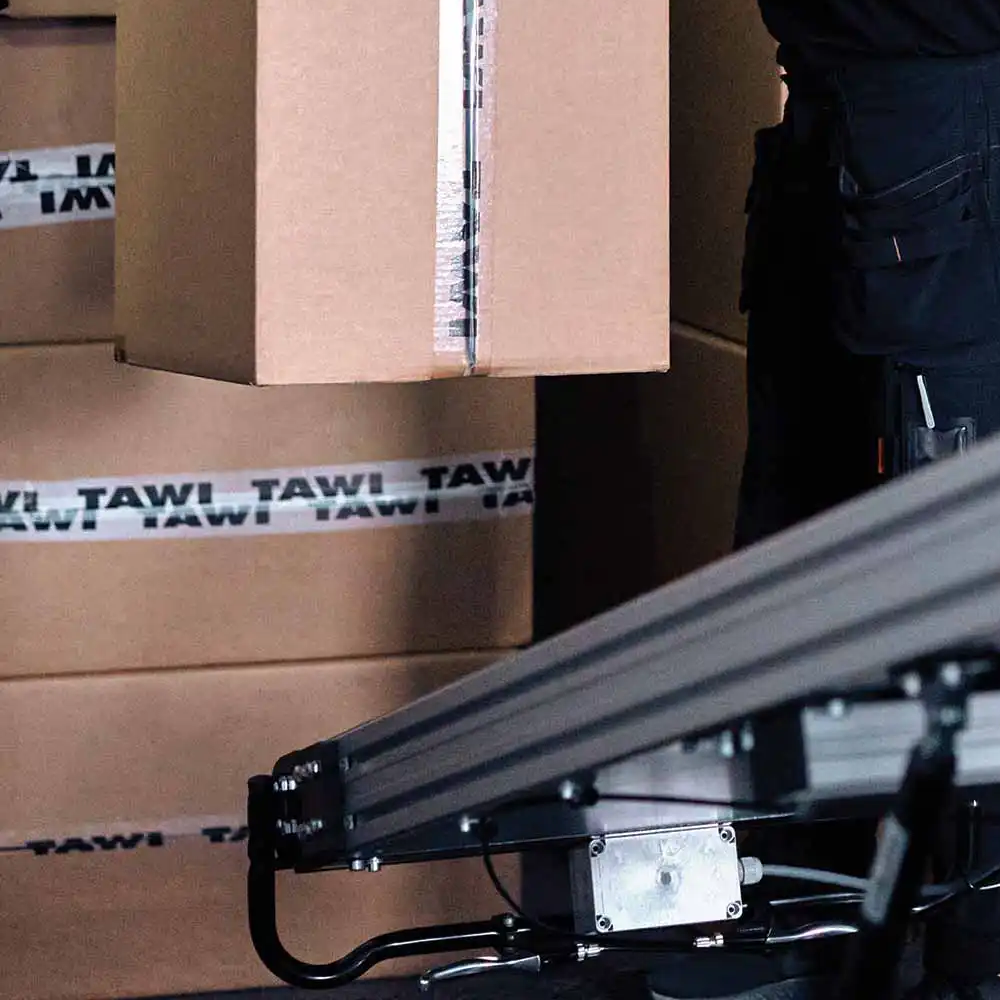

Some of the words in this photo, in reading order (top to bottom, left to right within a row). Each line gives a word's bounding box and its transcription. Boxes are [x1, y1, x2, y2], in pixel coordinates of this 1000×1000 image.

[78, 483, 213, 511] TAWI
[251, 472, 383, 501] TAWI
[420, 458, 532, 490] TAW
